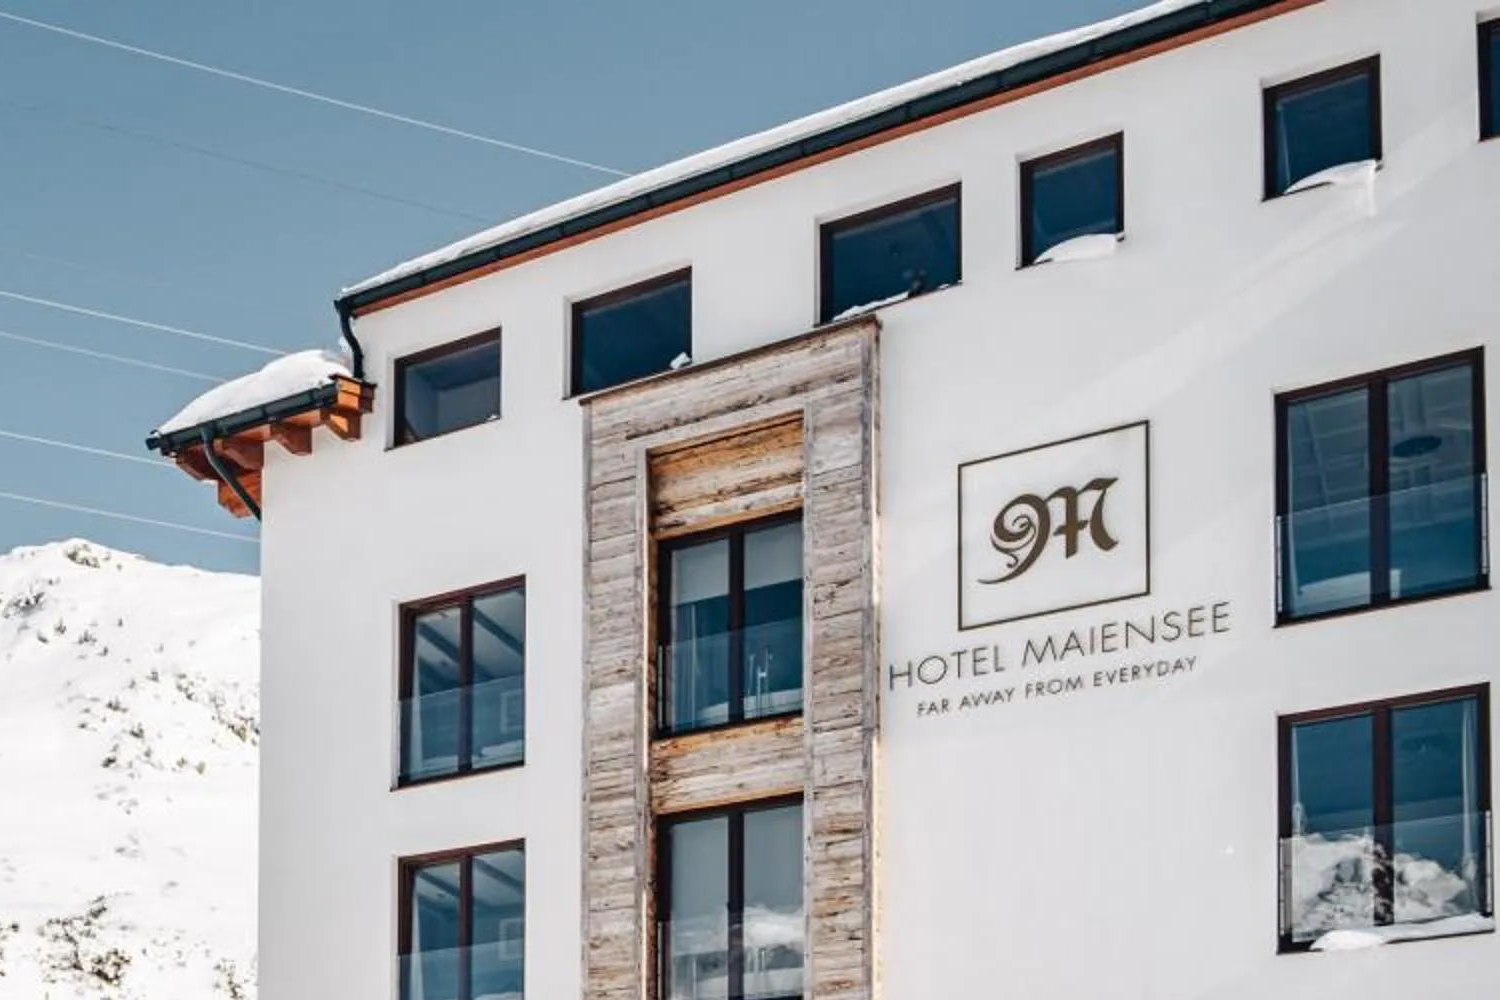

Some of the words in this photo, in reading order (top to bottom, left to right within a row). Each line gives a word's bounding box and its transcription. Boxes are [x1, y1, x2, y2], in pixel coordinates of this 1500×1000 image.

[889, 645, 1005, 691] HOTEL
[1021, 601, 1231, 669] MAIENSEE
[917, 699, 949, 717] FAR
[959, 687, 1015, 712] AWAY
[1025, 675, 1084, 698] FROM
[1093, 655, 1197, 688] EVERYDAY
